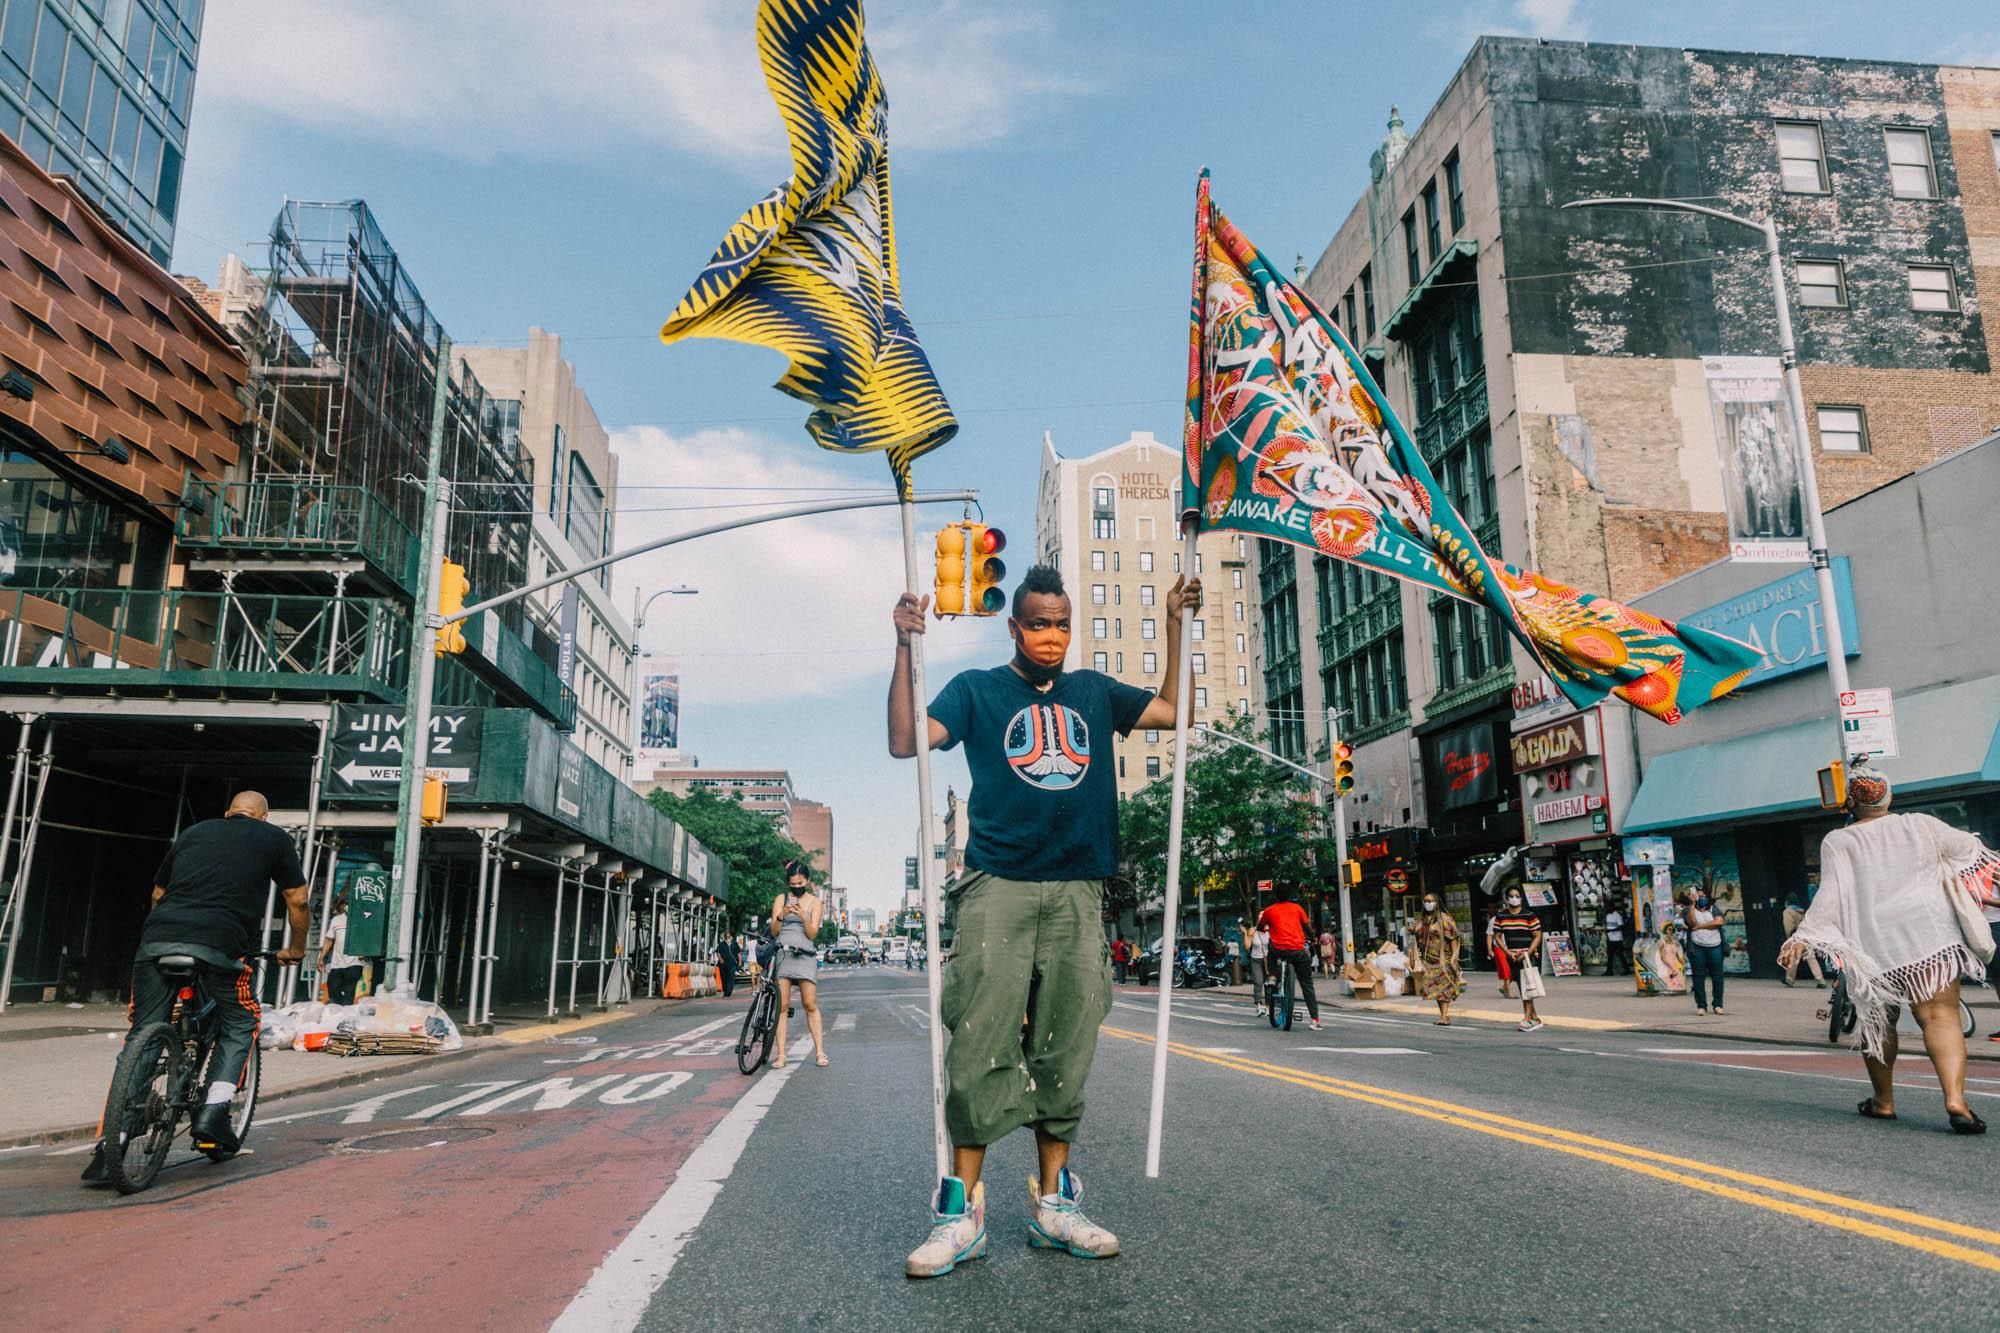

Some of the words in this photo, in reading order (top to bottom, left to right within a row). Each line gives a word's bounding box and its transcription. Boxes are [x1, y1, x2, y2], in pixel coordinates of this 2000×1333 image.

[1121, 472, 1164, 486] HOTEL
[1118, 487, 1170, 501] THERESA
[1226, 498, 1310, 530] AWAKE
[1314, 518, 1357, 543] AT
[1355, 531, 1412, 565] ALL
[1735, 543, 1808, 560] Burlington
[561, 632, 571, 685] OPULAR
[359, 735, 453, 754] JAZ
[1526, 727, 1571, 765] GOLD
[369, 769, 401, 779] WE'R
[425, 769, 449, 779] PEN
[1536, 801, 1583, 822] HARLEM
